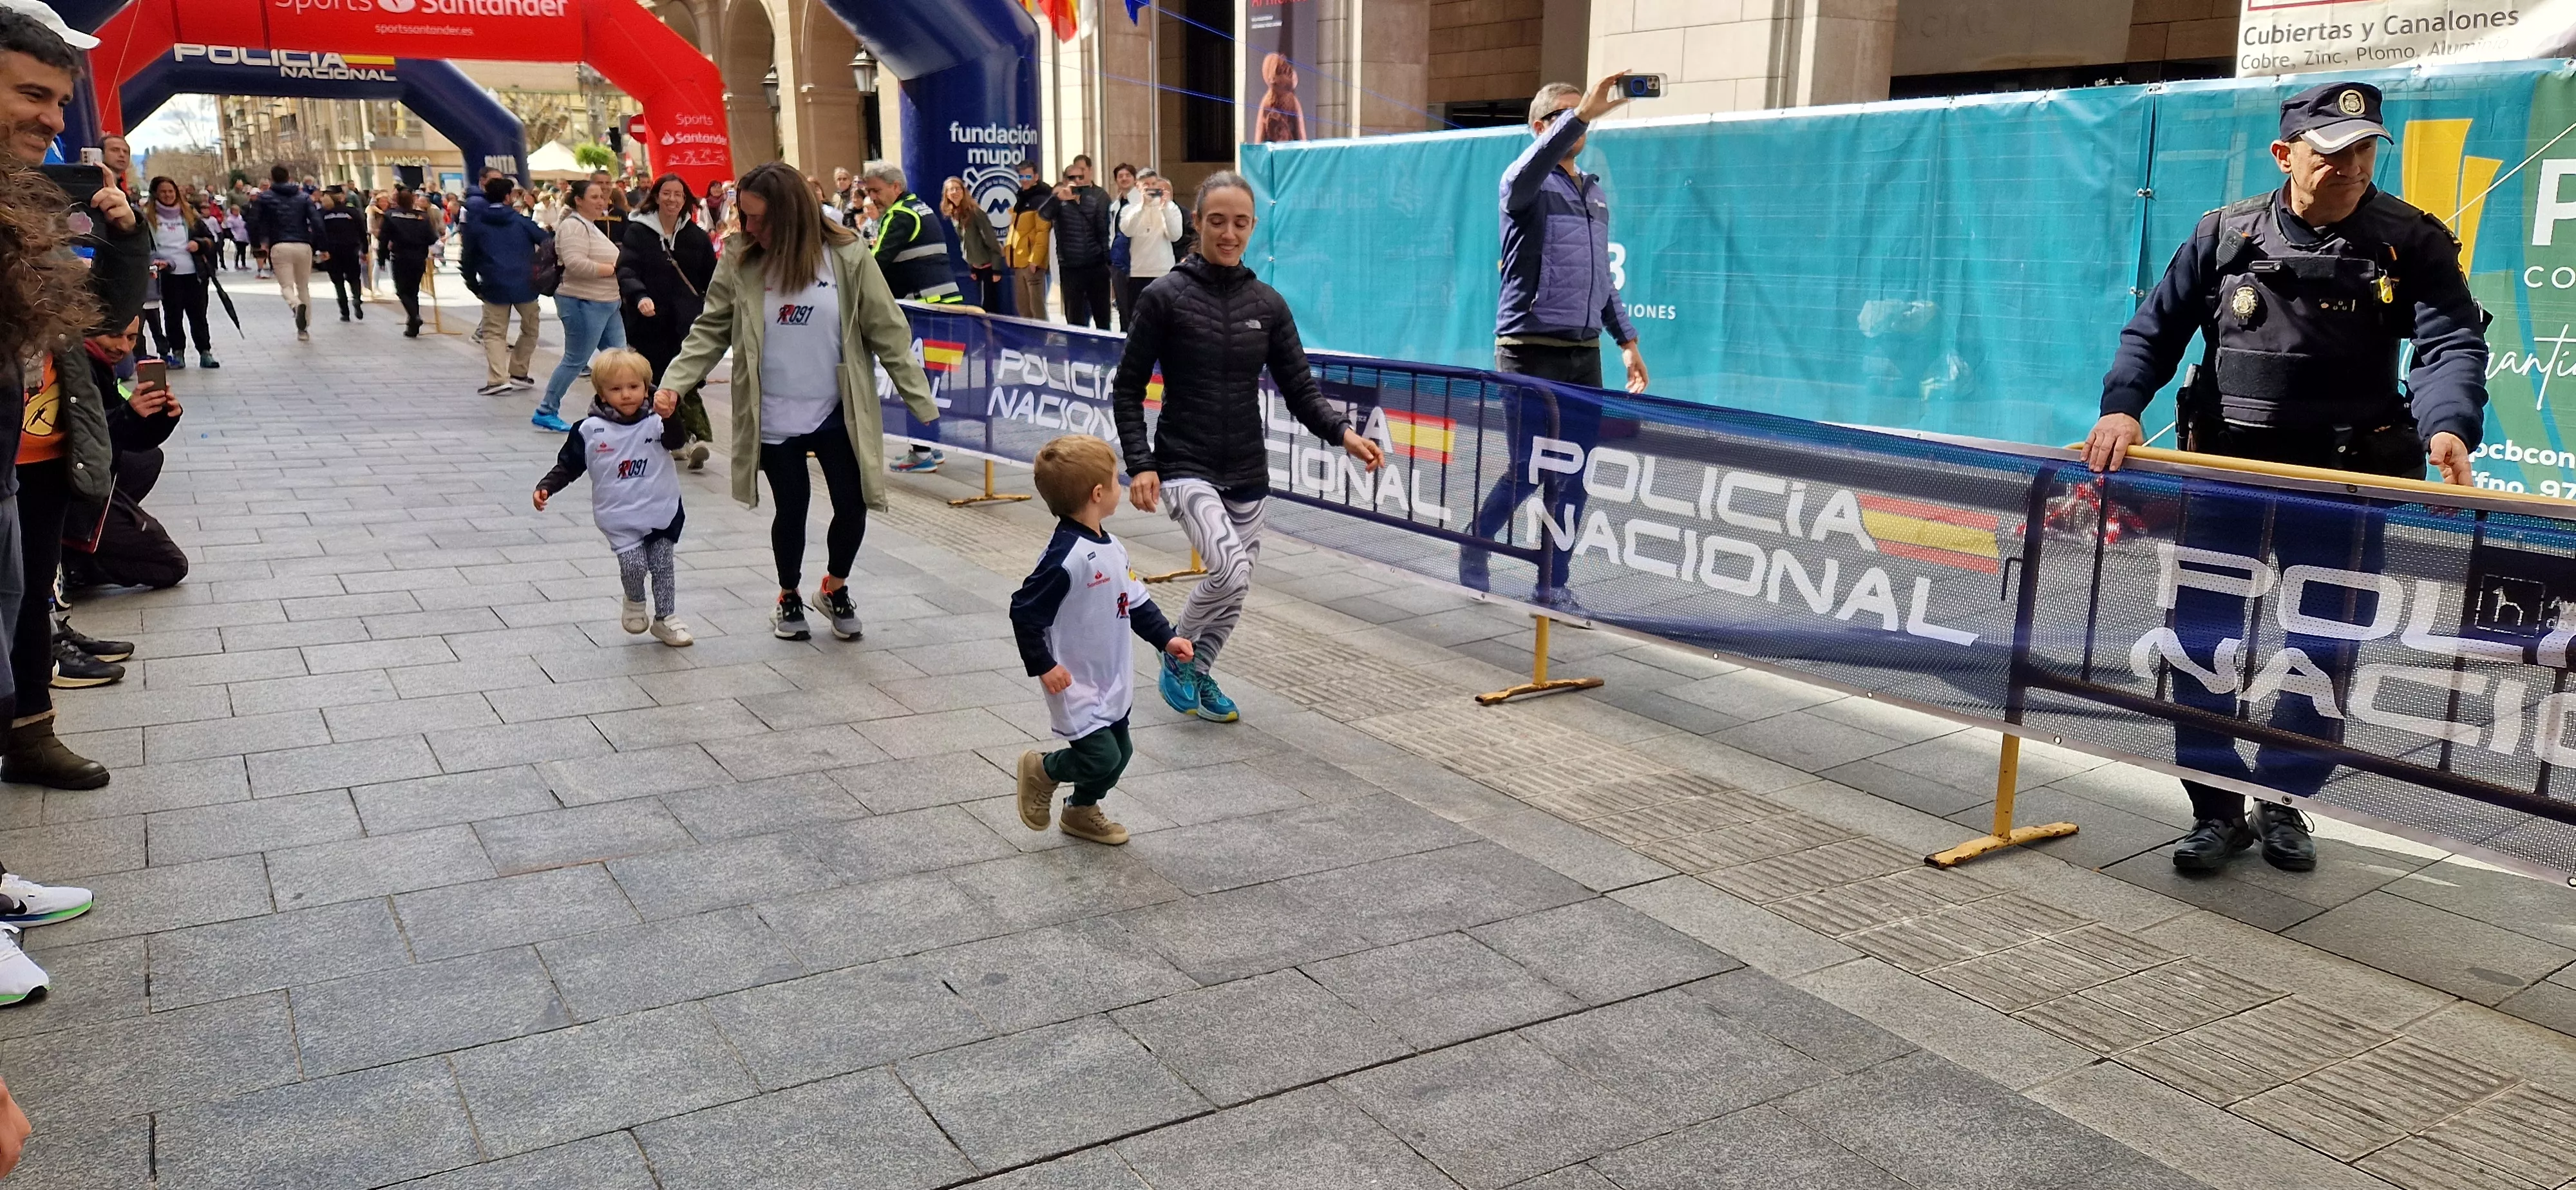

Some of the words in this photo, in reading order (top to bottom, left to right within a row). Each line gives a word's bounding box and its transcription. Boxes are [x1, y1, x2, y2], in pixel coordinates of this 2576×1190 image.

[375, 23, 475, 36] sportssantander.es
[2244, 24, 2353, 46] Cubiertas
[2362, 22, 2375, 42] y
[2384, 10, 2519, 35] Canalones
[2241, 53, 2297, 70] Cobre,
[2303, 50, 2349, 66] Zinc,
[2356, 44, 2421, 62] Plomo,
[280, 66, 397, 81] NACIONAL
[675, 112, 714, 127] Sports
[949, 120, 1038, 145] fundación
[384, 155, 430, 167] MANGO
[968, 144, 1025, 168] mupol
[1526, 498, 1980, 645] NACIONAL
